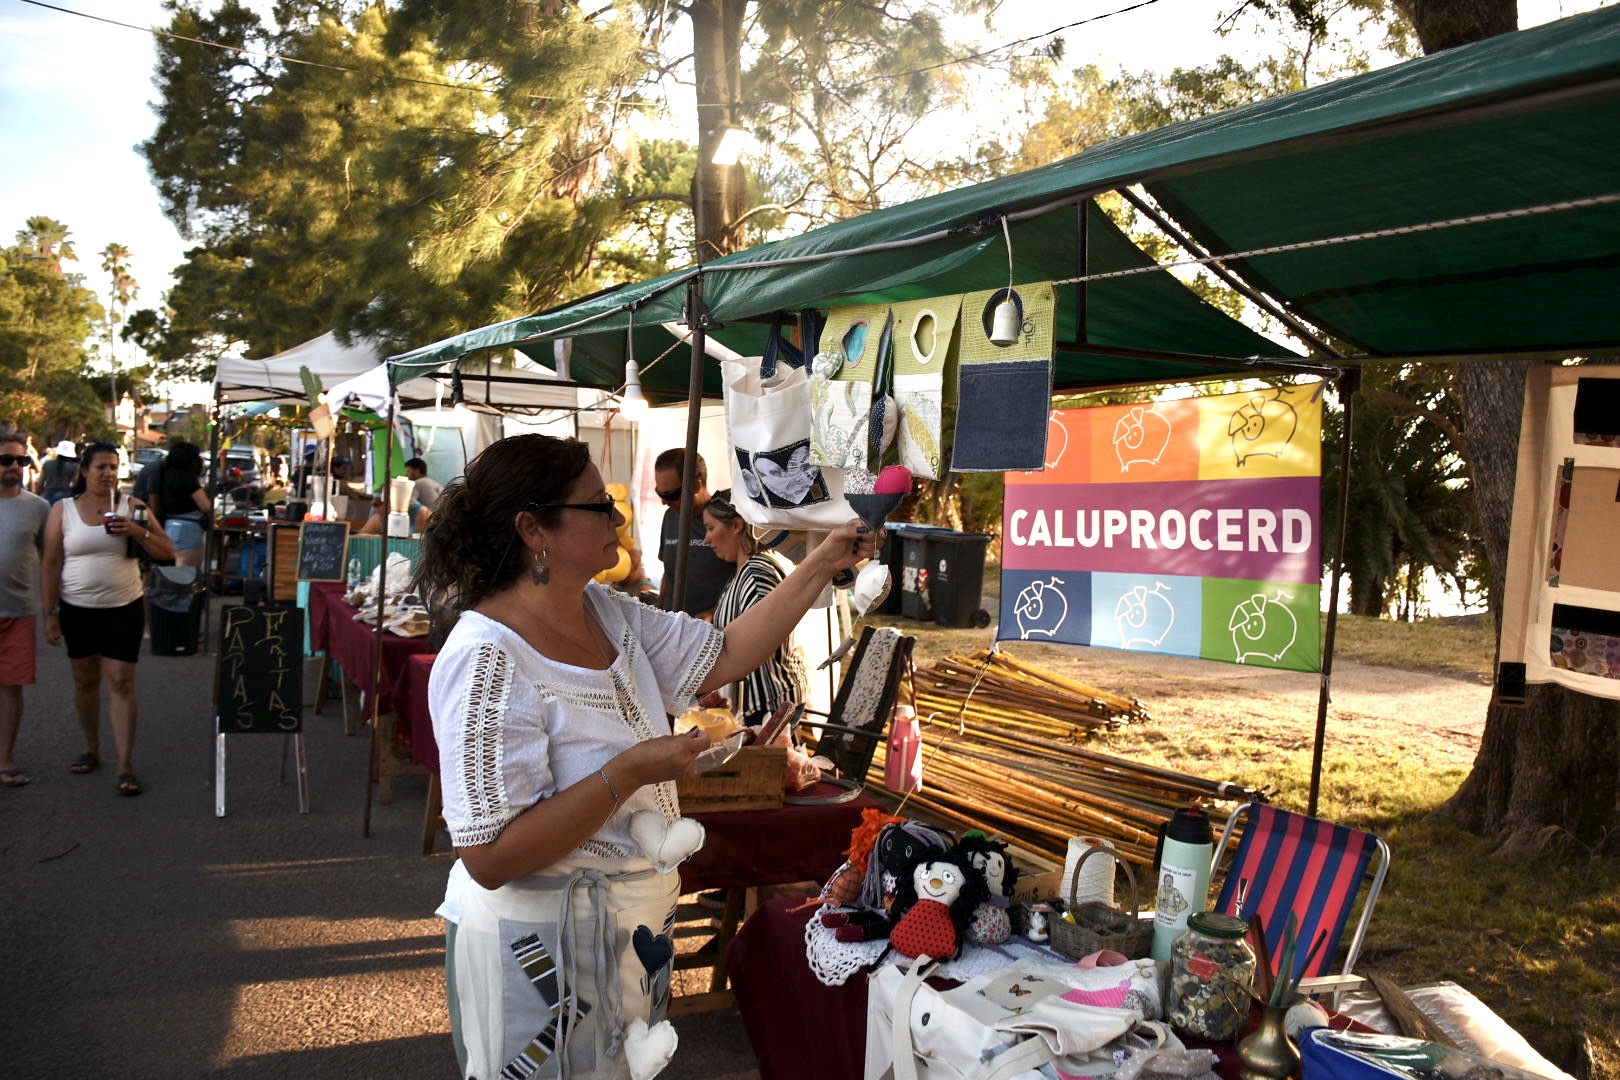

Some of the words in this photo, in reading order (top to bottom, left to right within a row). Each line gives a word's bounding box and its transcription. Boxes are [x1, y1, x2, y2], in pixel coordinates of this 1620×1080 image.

[1010, 508, 1312, 554] CALUPROCERD
[223, 606, 256, 729] PAPAS
[254, 609, 298, 730] FRITAS
